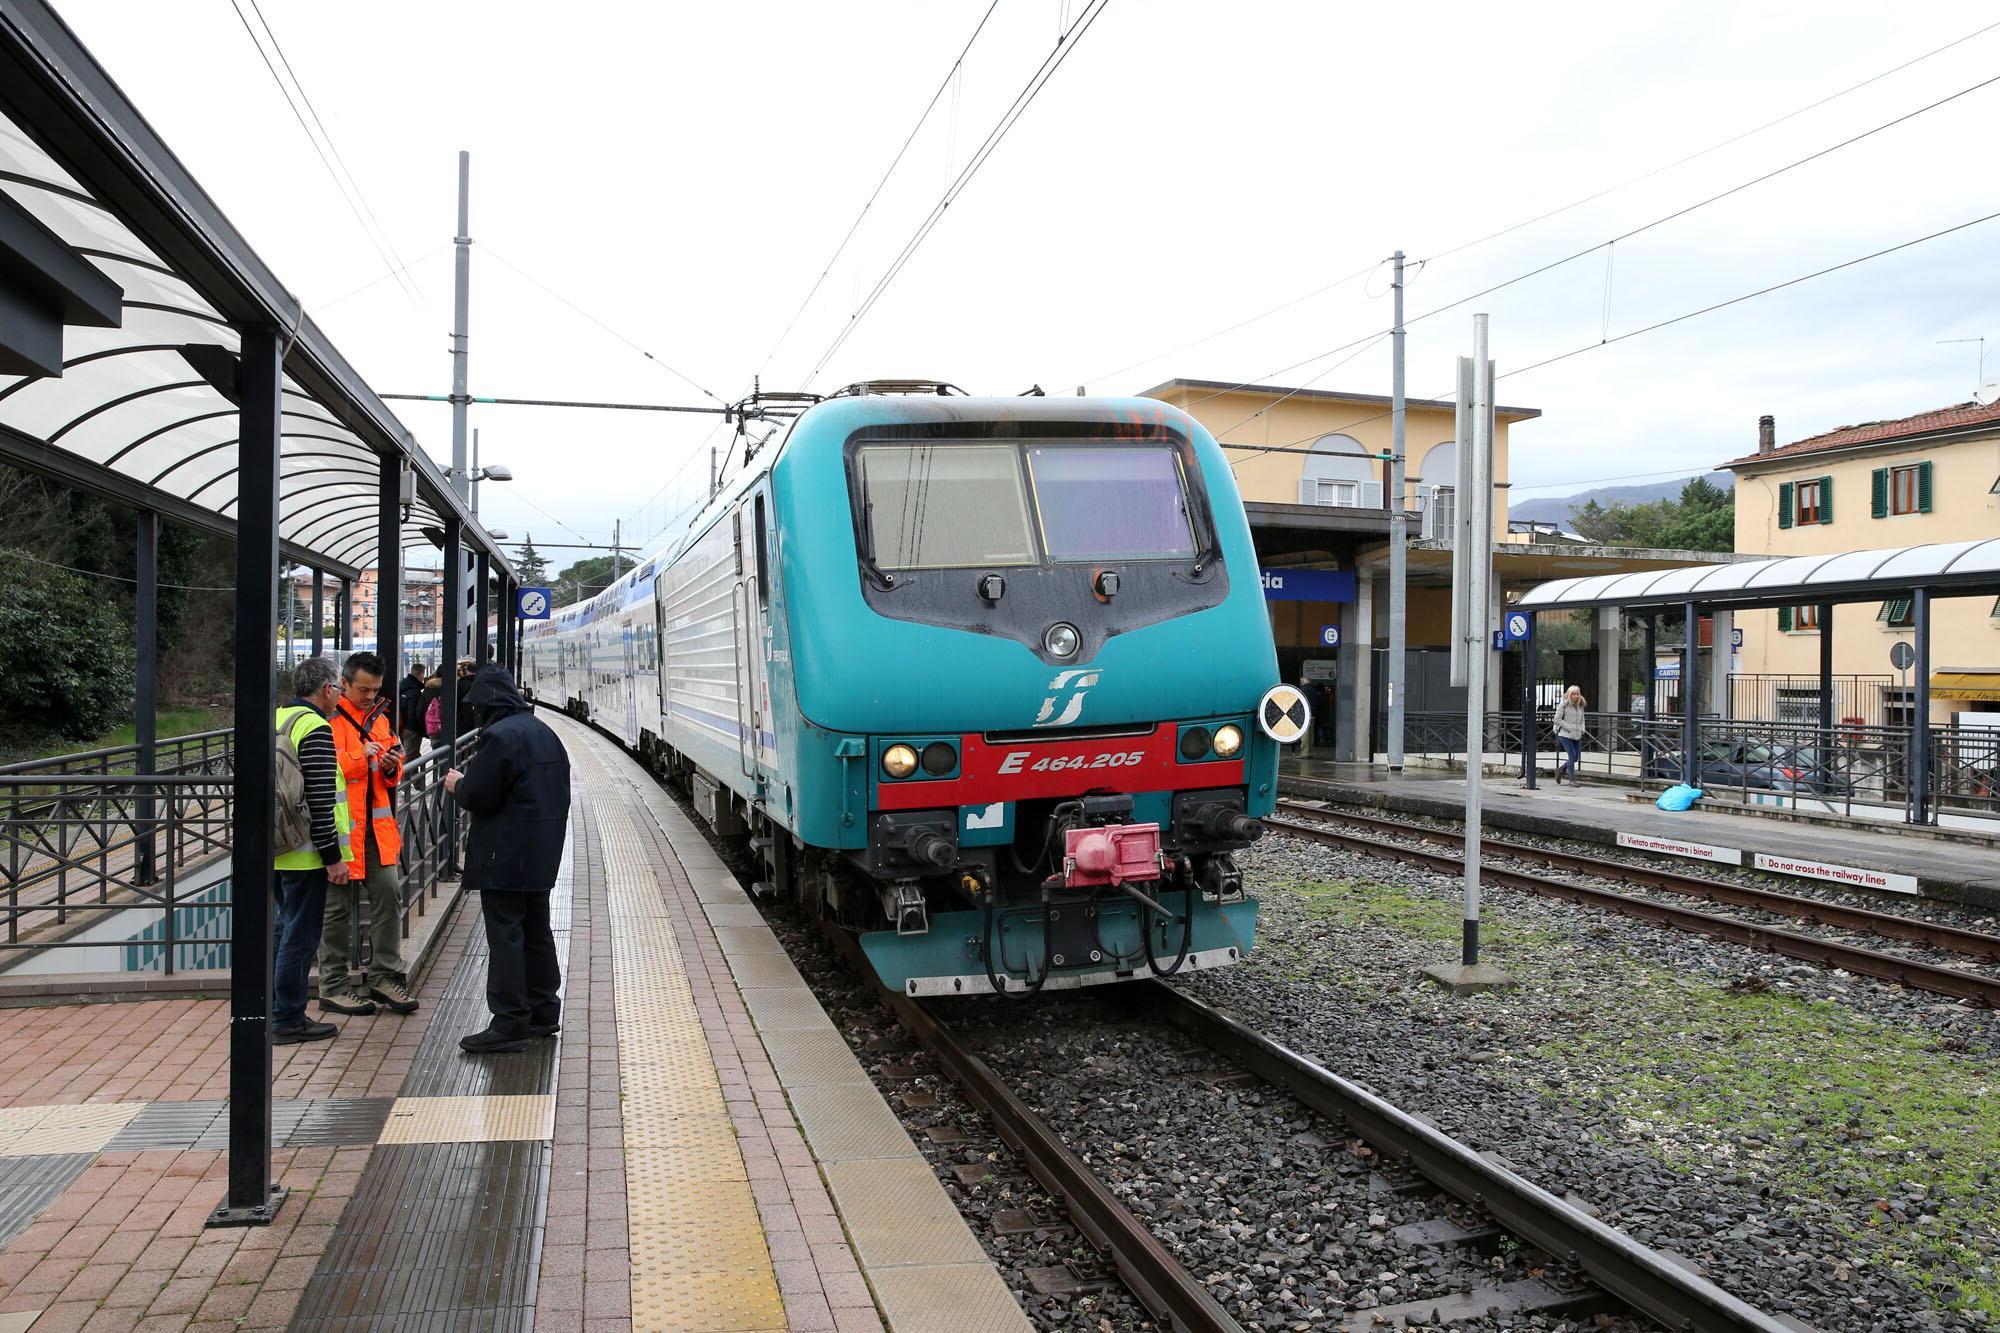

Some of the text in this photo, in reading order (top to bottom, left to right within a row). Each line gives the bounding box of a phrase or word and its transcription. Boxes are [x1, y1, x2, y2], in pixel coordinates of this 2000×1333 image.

[998, 751, 1145, 775] E 464.205
[1627, 837, 1649, 847] Vietato
[1649, 842, 1689, 854] attraversare
[1693, 849, 1713, 857] binari
[1768, 859, 1887, 886] Do not cross the railway lines
